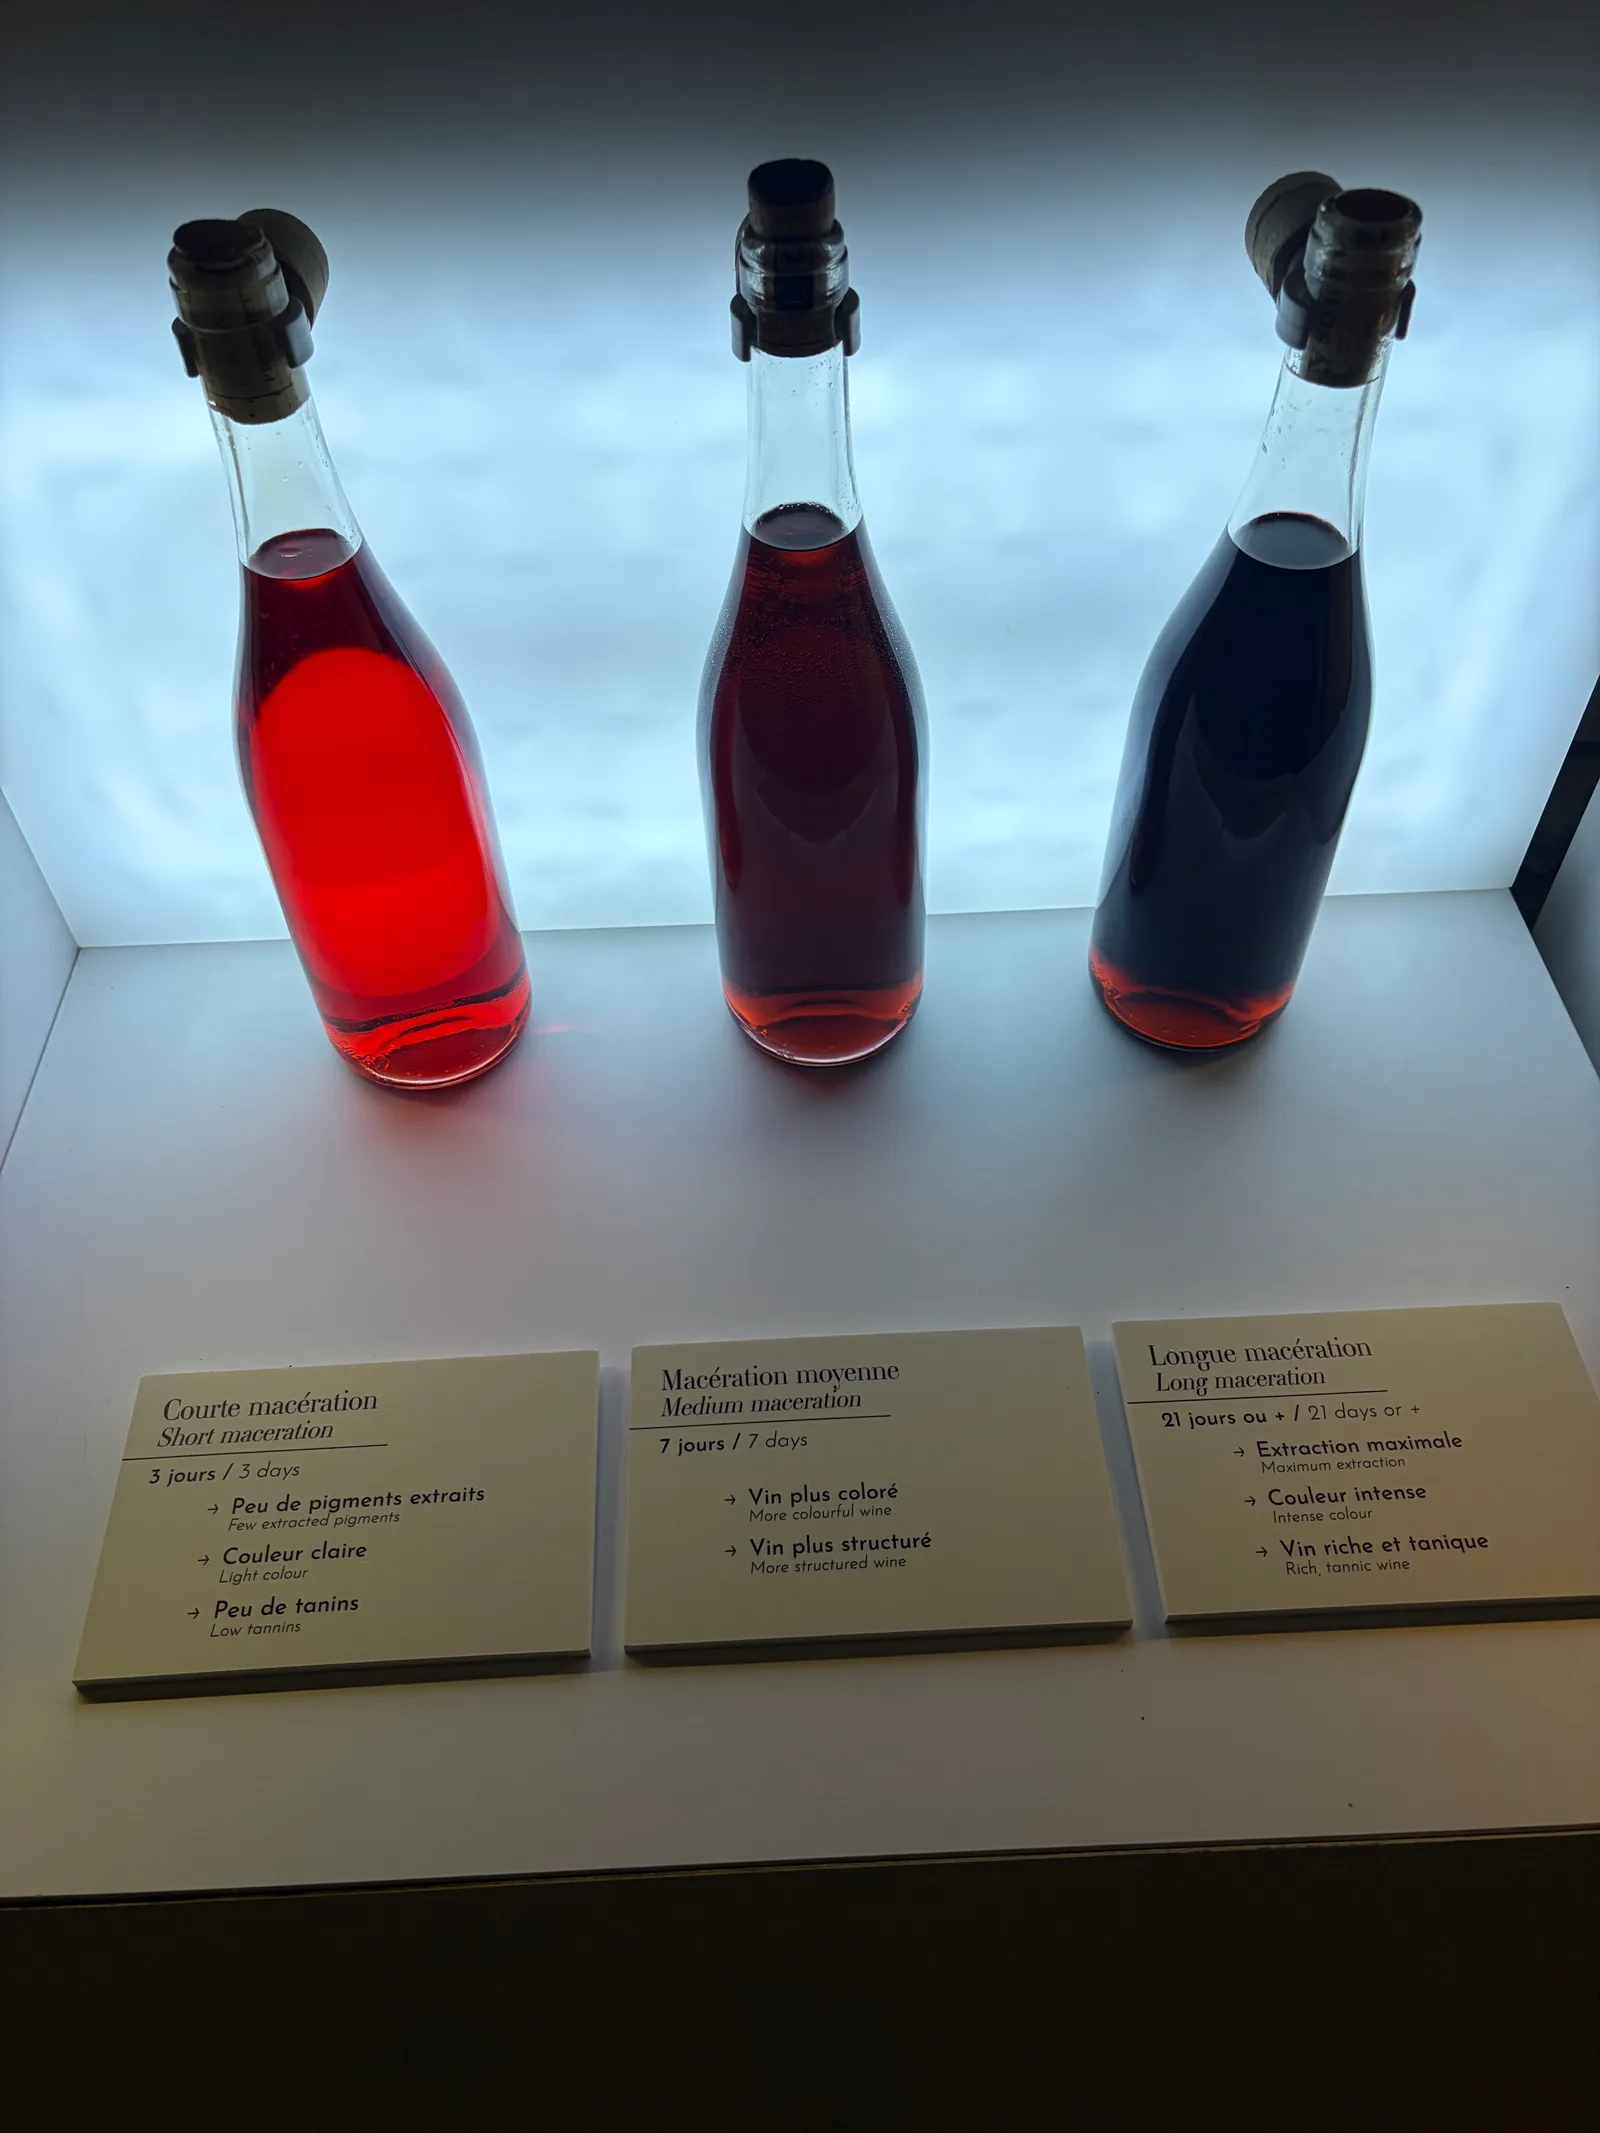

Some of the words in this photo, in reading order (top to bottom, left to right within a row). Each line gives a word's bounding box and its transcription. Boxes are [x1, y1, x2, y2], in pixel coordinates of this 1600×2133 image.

[1147, 1344, 1237, 1372] Longue
[1243, 1336, 1373, 1362] macération
[661, 1365, 789, 1391] Macération
[796, 1365, 899, 1393] moyenne
[1156, 1372, 1209, 1397] Long
[1215, 1366, 1326, 1389] maceration
[163, 1398, 241, 1421] Courte
[247, 1389, 377, 1417] macération
[661, 1395, 743, 1417] Medium
[751, 1391, 861, 1413] maceration
[1161, 1411, 1181, 1428] 21
[1188, 1411, 1237, 1430] jours
[1243, 1412, 1267, 1424] ou
[1275, 1411, 1285, 1421] +
[1293, 1404, 1300, 1422] /
[1307, 1404, 1327, 1421] 21
[1334, 1401, 1378, 1422] days
[1383, 1406, 1402, 1417] or
[1410, 1405, 1420, 1414] +
[156, 1426, 215, 1448] Short
[219, 1420, 334, 1444] maceration
[659, 1438, 671, 1454] 7
[678, 1438, 725, 1457] jours
[732, 1432, 741, 1451] /
[748, 1433, 759, 1449] 7
[765, 1430, 808, 1451] days
[1256, 1439, 1360, 1458] Extraction
[1366, 1430, 1462, 1452] maximale
[148, 1468, 162, 1485] 3
[166, 1468, 216, 1487] jours
[222, 1462, 235, 1481] /
[238, 1463, 251, 1479] 3
[256, 1460, 301, 1481] days
[1261, 1460, 1332, 1474] Maximum
[1336, 1456, 1406, 1470] extraction
[231, 1497, 269, 1515] Peu
[276, 1493, 302, 1512] de
[308, 1491, 402, 1517] pigments
[409, 1487, 485, 1505] extraits
[748, 1487, 782, 1506] Vin
[790, 1484, 831, 1507] plus
[838, 1481, 899, 1501] coloré
[1268, 1485, 1348, 1506] Couleur
[1353, 1486, 1427, 1502] intense
[227, 1517, 258, 1532] Few
[261, 1511, 331, 1530] extracted
[332, 1511, 400, 1529] pigments
[749, 1508, 787, 1523] More
[790, 1503, 854, 1521] colourful
[859, 1505, 892, 1517] wine
[1273, 1510, 1324, 1524] Intense
[1328, 1505, 1373, 1521] colour
[223, 1544, 304, 1565] Couleur
[310, 1541, 367, 1560] claire
[749, 1537, 784, 1557] Vin
[792, 1534, 834, 1558] plus
[841, 1531, 932, 1552] structuré
[1279, 1539, 1317, 1558] Vin
[1323, 1535, 1373, 1556] riche
[1381, 1536, 1401, 1553] et
[1408, 1534, 1489, 1554] tanique
[218, 1567, 259, 1586] Light
[262, 1564, 309, 1581] colour
[750, 1560, 789, 1575] More
[792, 1556, 868, 1573] structured
[873, 1558, 907, 1569] wine
[1285, 1559, 1322, 1577] Rich,
[1325, 1560, 1372, 1574] tannic
[1376, 1559, 1410, 1571] wine
[214, 1600, 253, 1619] Peu
[260, 1596, 287, 1616] de
[295, 1595, 359, 1614] tanins
[209, 1623, 243, 1638] Low
[247, 1621, 301, 1635] tannins
